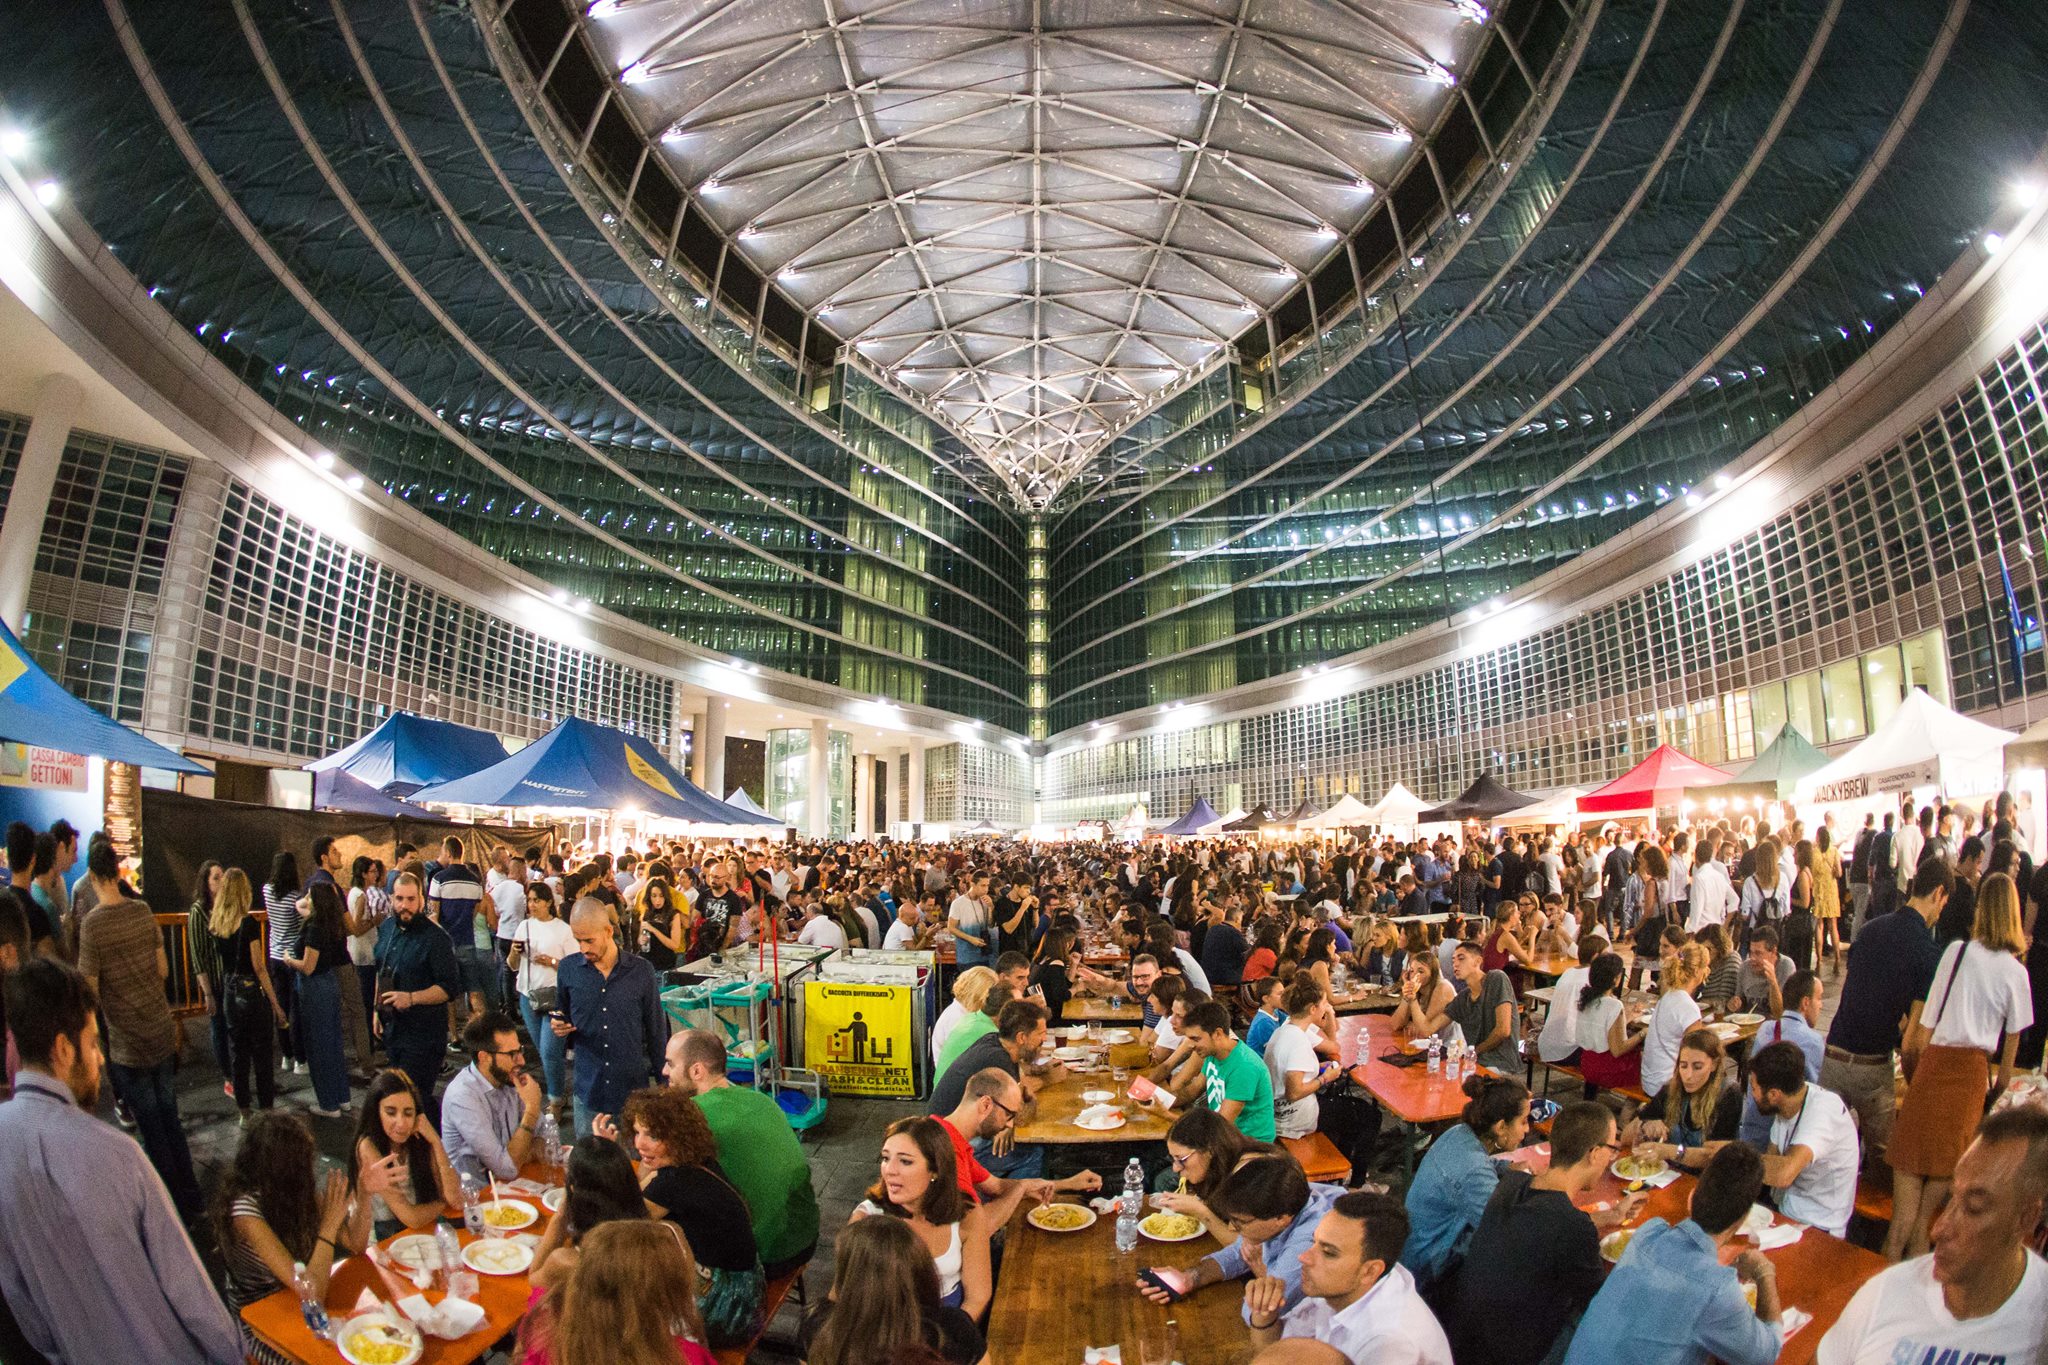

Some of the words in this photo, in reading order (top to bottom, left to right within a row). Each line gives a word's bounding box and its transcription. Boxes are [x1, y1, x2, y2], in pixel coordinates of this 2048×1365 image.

[31, 747, 55, 764] CASSA
[31, 763, 73, 786] GETTONI
[521, 779, 587, 795] MASTERTENT
[828, 989, 852, 997] RACCOLTA
[813, 1064, 908, 1076] TRANSENNE.NET
[821, 1075, 909, 1085] RASH&CLEAN
